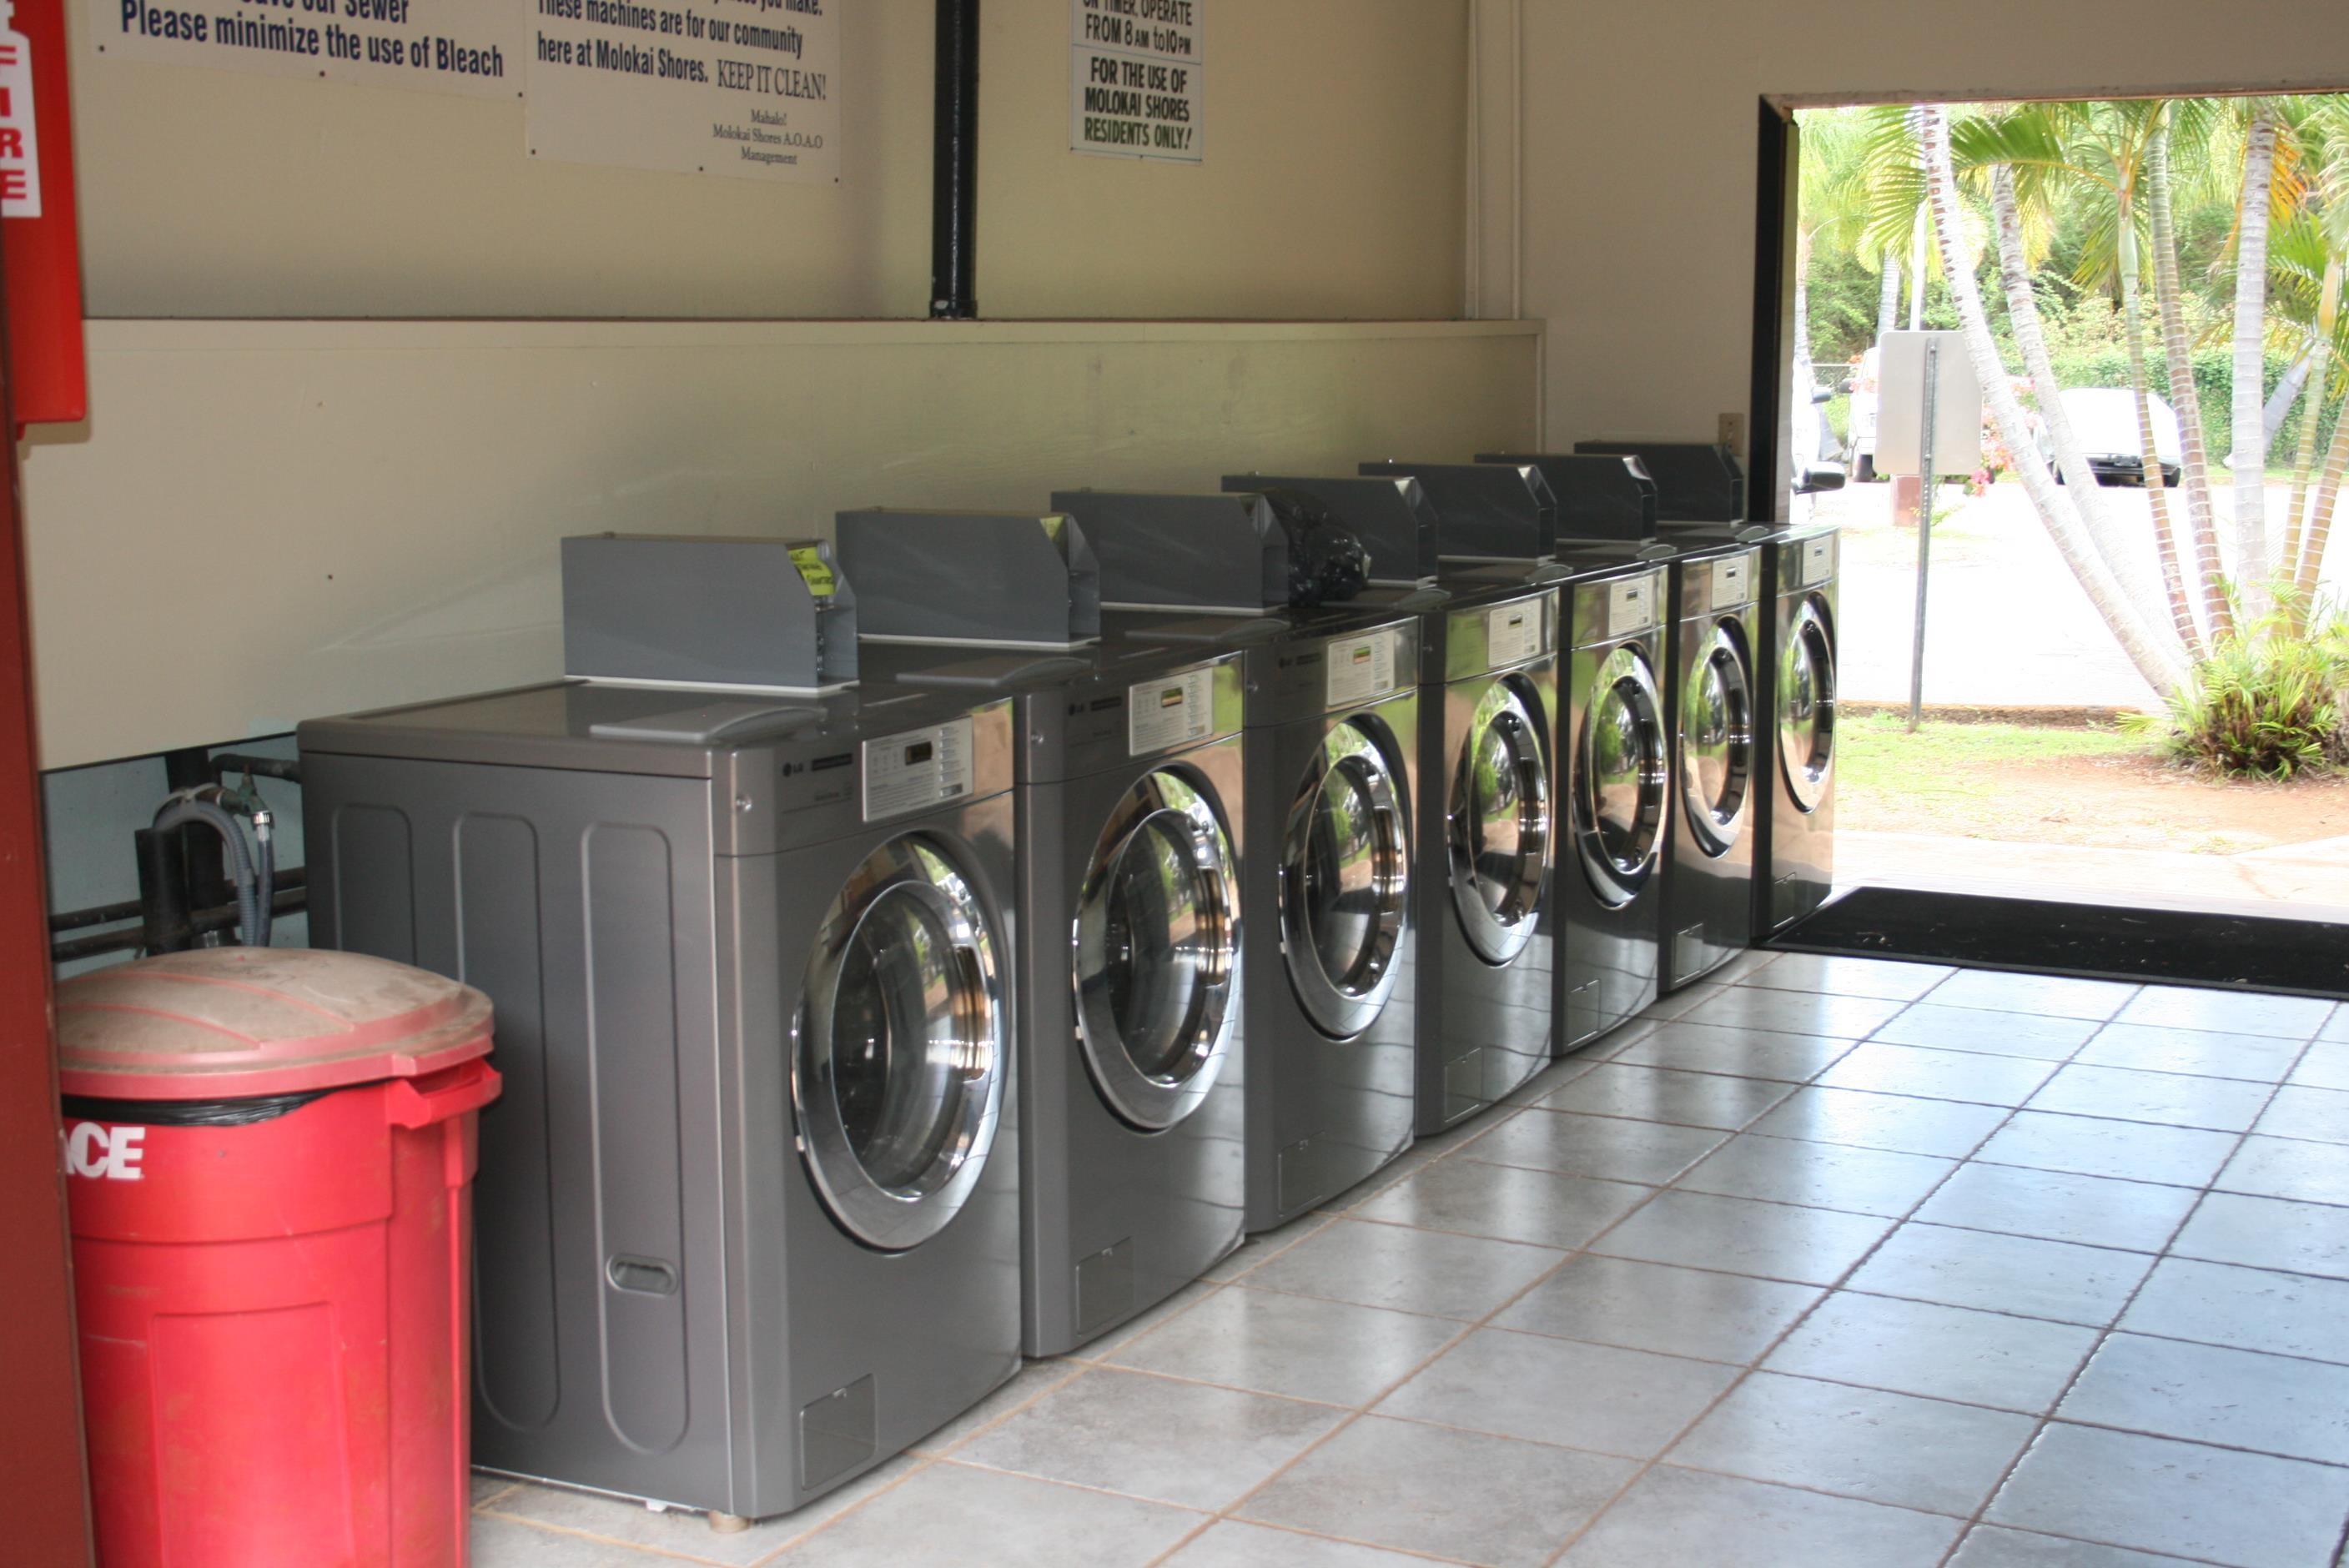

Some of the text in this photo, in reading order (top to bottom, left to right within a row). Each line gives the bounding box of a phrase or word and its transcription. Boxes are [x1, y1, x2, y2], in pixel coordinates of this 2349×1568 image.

[586, 0, 656, 32] machines
[660, 11, 682, 35] are
[686, 8, 706, 39] for
[708, 18, 730, 42] our
[734, 23, 802, 60] community
[1086, 13, 1121, 44] FROM
[1141, 0, 1192, 27] OPERATE
[121, 0, 503, 77] Please minimize the use of Bleach
[537, 30, 826, 100] here at Molokai Shores. KEEP IT CLEAN!
[1091, 57, 1187, 93] FOR THE USE OF
[751, 108, 787, 126] Mahalo!
[1085, 87, 1190, 123] MOLOKAI SHORES
[713, 123, 750, 141] Molokai
[752, 128, 782, 144] Shores
[1084, 117, 1192, 150] RESIDENTS ONLY!
[741, 146, 797, 165] Management
[66, 1121, 146, 1179] CE
